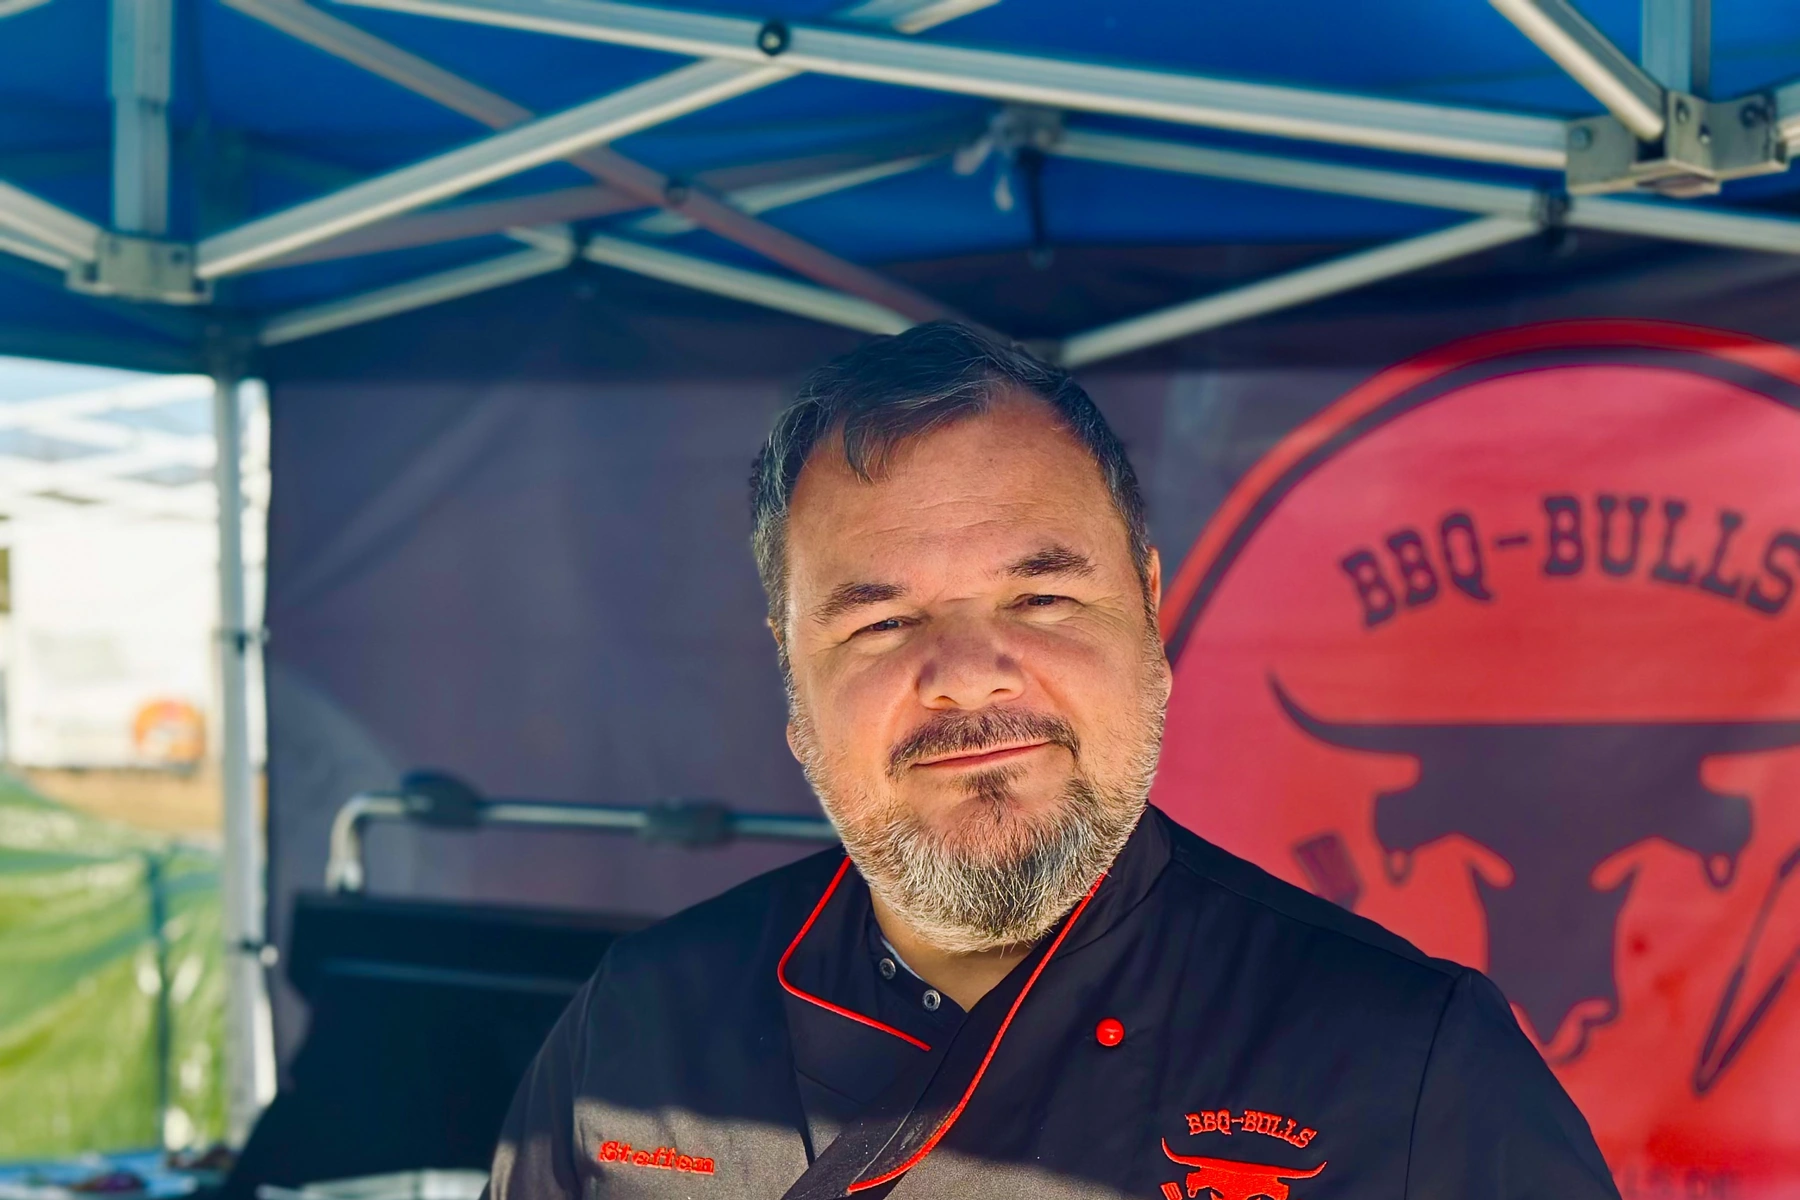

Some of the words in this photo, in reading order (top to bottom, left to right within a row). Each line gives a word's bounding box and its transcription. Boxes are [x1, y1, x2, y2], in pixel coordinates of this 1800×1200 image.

[1340, 495, 1800, 628] BBQ-BULLS
[1184, 1108, 1318, 1149] BBQ-BULLS
[599, 1140, 715, 1175] Steffen
